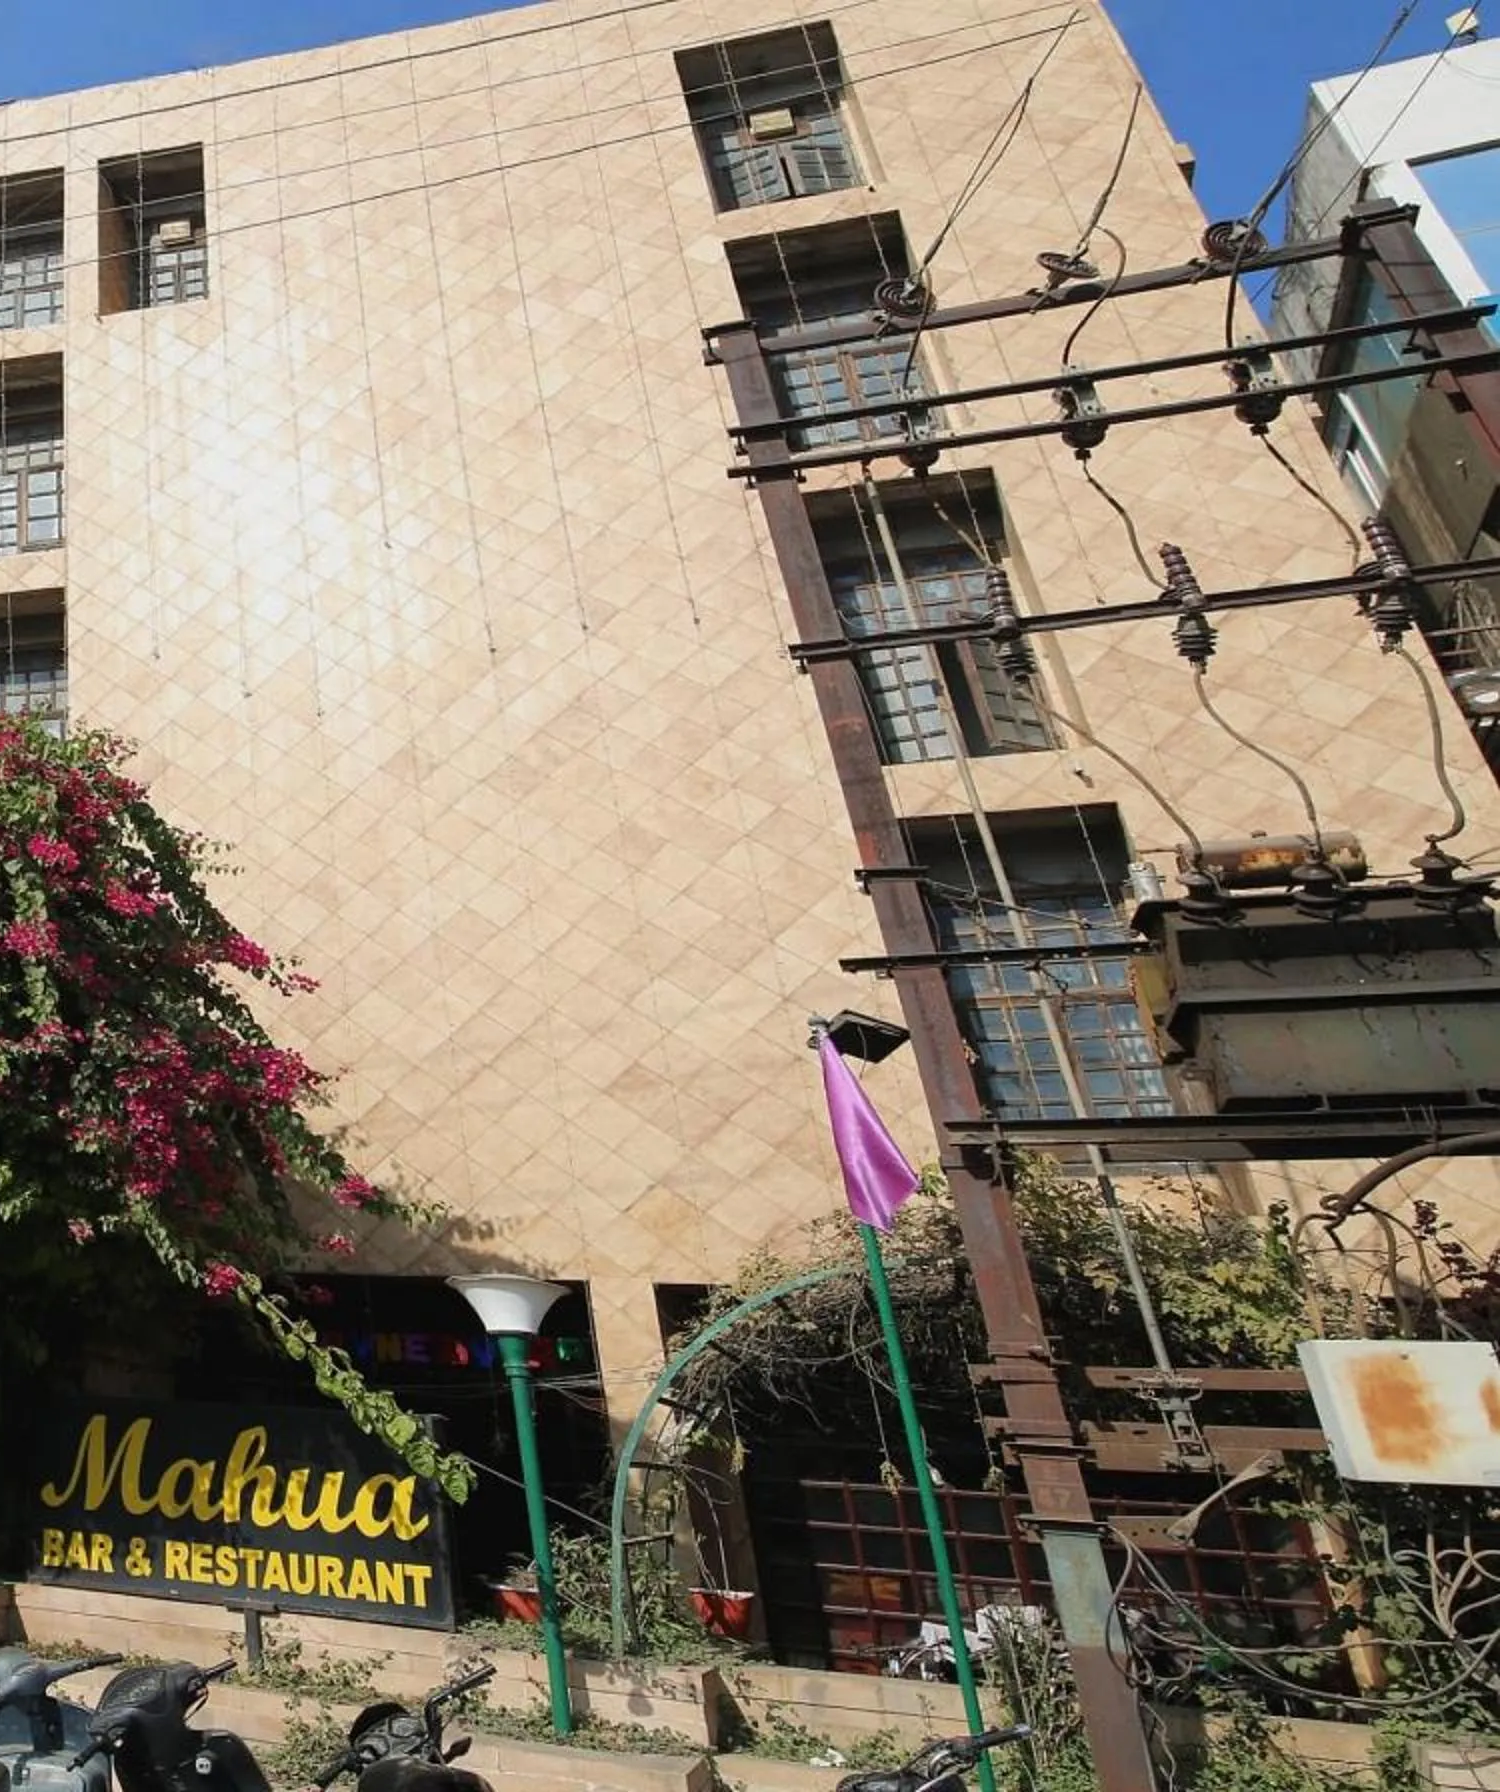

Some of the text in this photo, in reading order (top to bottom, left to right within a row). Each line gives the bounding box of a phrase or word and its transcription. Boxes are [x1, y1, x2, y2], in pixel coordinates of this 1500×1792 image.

[40, 1414, 430, 1542] Mahua
[41, 1528, 433, 1608] BAR & RESTAURANT
